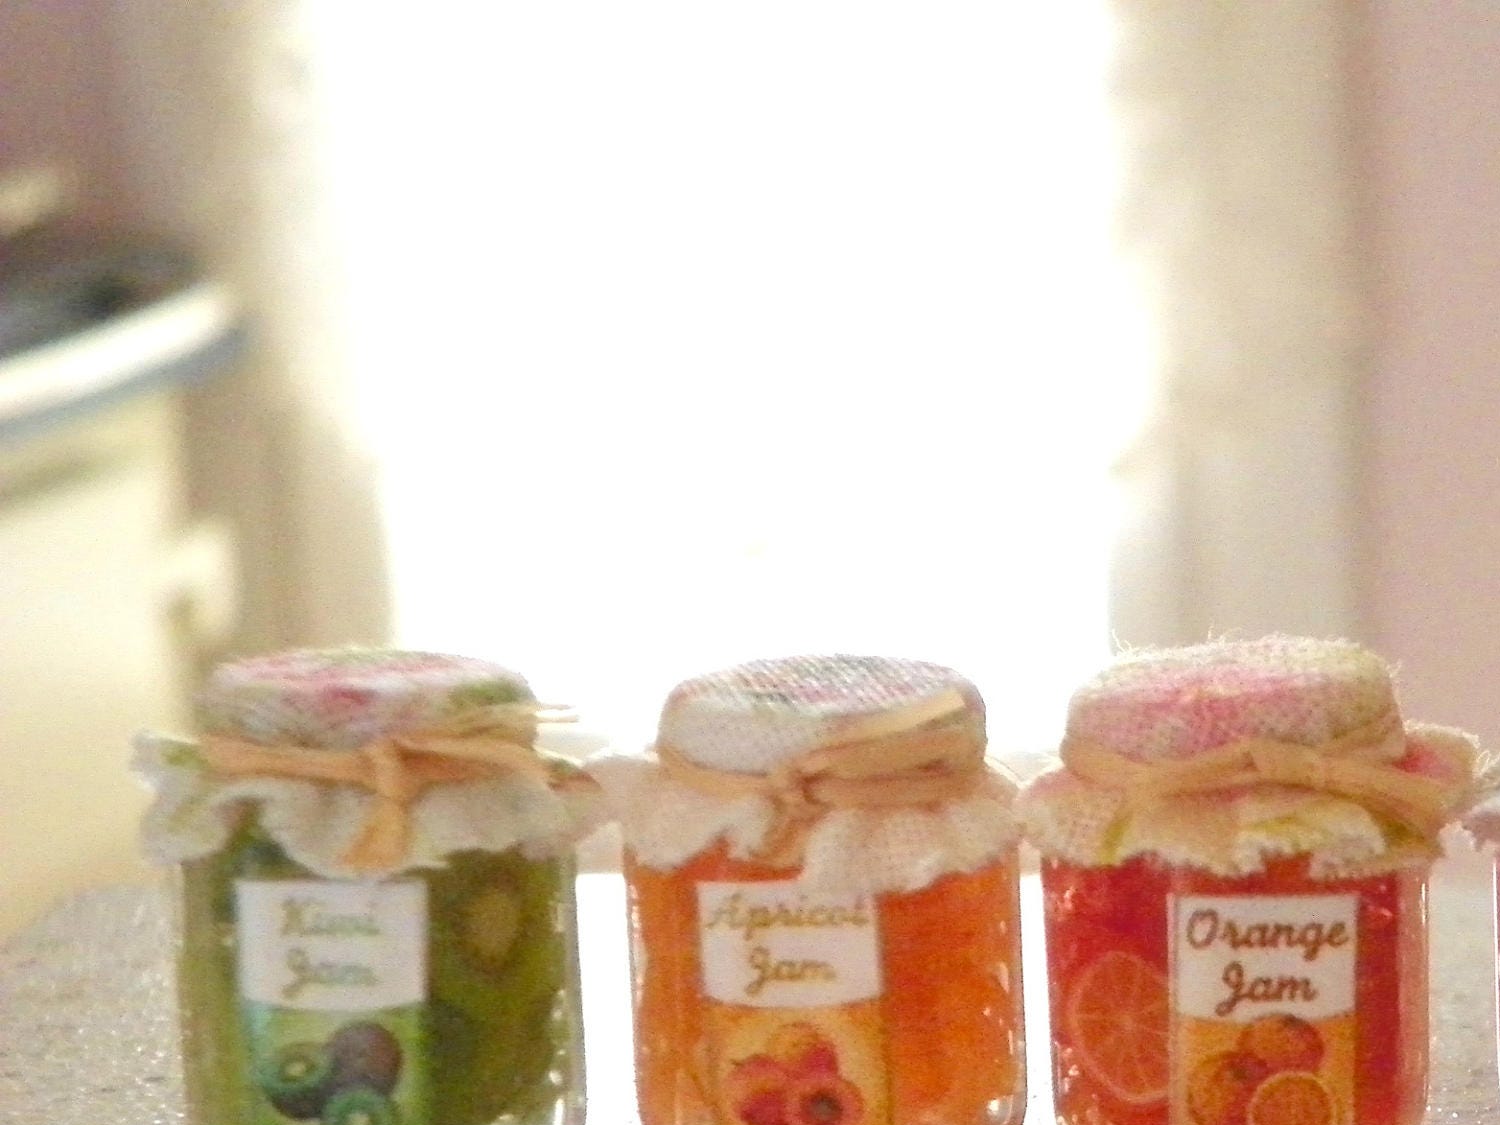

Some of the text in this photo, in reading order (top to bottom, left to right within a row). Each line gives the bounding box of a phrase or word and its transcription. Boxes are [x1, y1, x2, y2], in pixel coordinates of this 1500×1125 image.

[1186, 907, 1348, 962] Orange
[744, 946, 837, 997] Jam
[1214, 960, 1320, 1017] Jam
